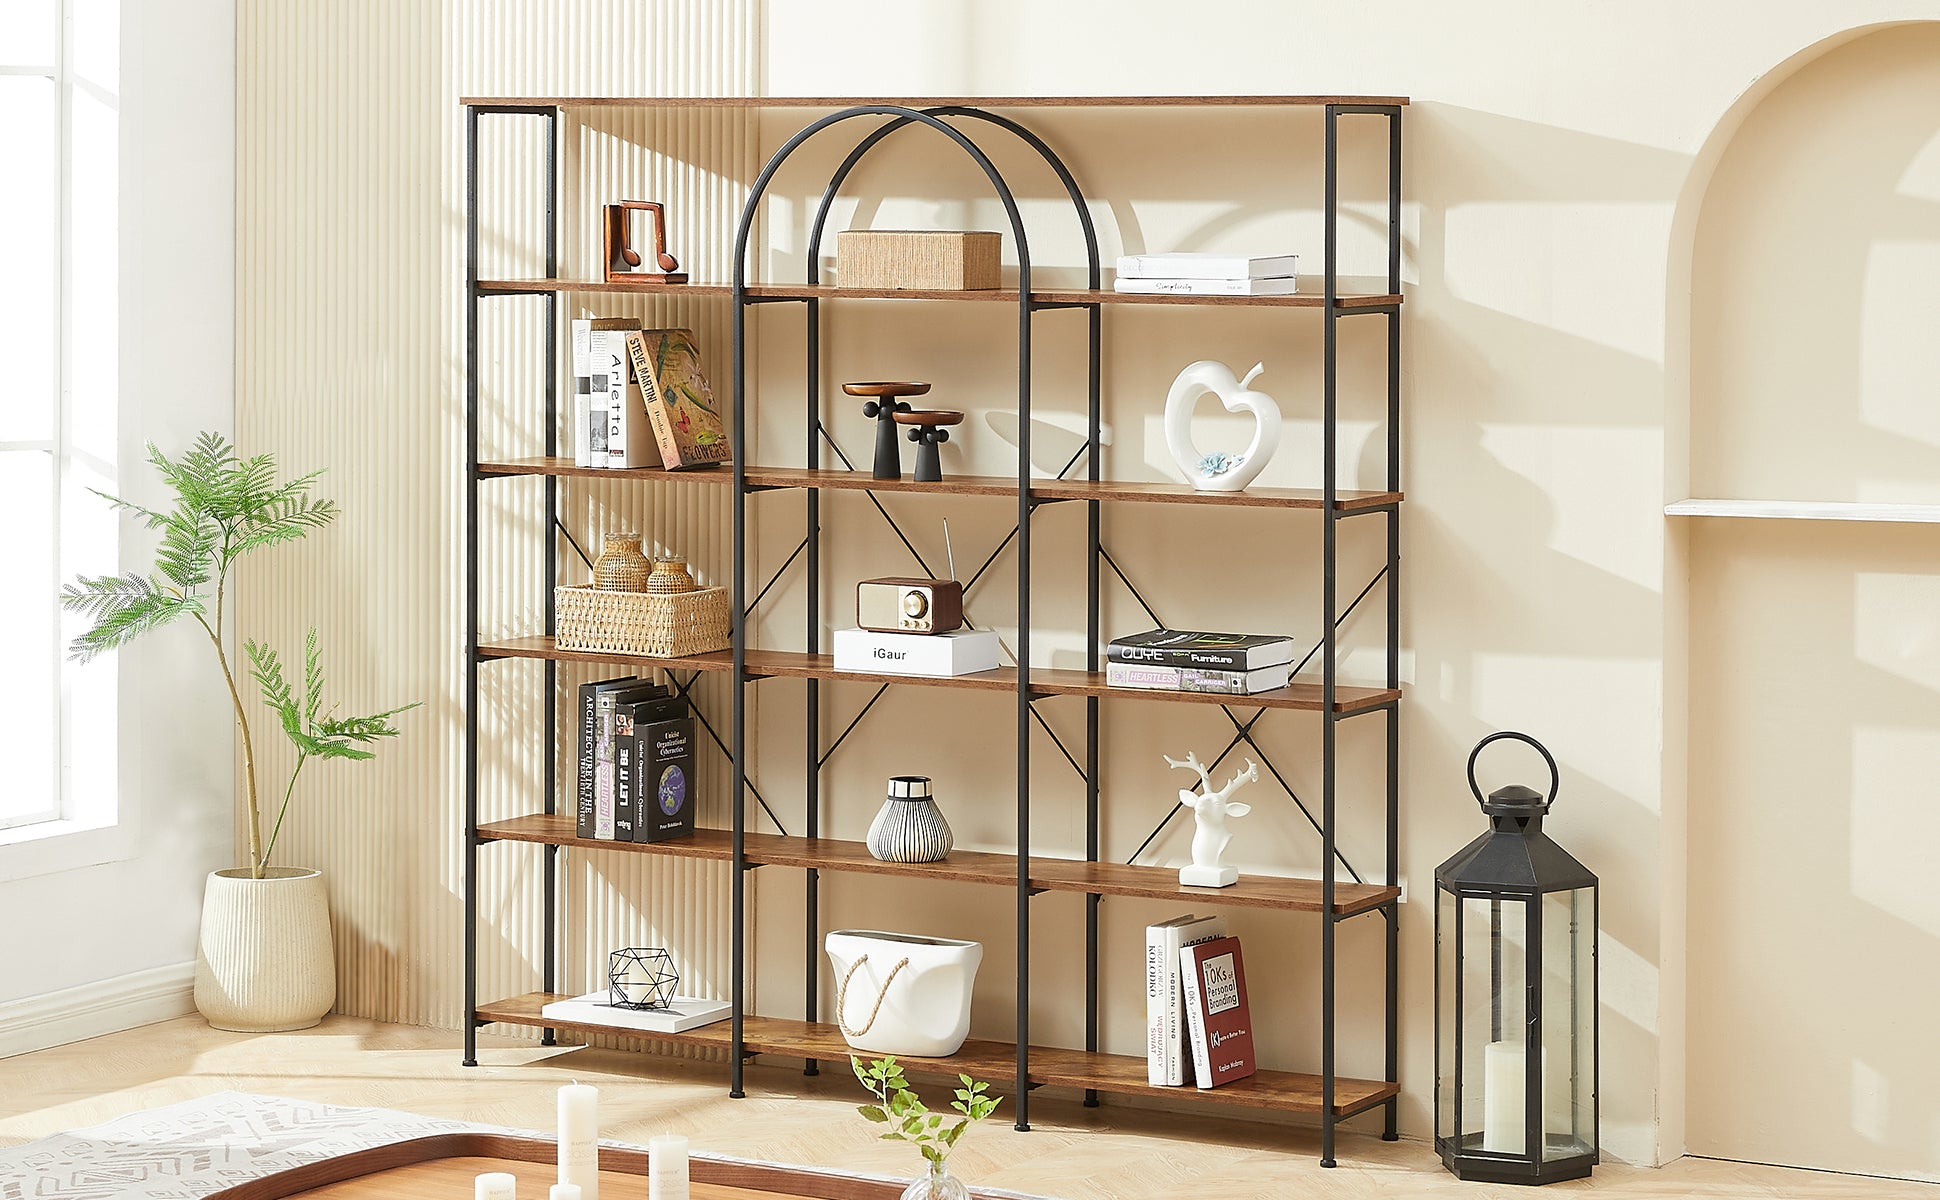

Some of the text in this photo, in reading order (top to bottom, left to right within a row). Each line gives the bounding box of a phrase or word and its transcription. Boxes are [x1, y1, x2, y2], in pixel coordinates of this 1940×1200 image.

[629, 337, 646, 368] STEVE
[638, 366, 658, 404] MARTINI
[611, 354, 622, 436] Arletta
[683, 441, 727, 462] FLOWERS
[873, 648, 907, 660] iGaur
[1191, 653, 1233, 664] Furniture
[1130, 672, 1178, 684] HEARTLESS
[585, 778, 592, 789] IN
[619, 748, 629, 806] LET IT BE
[600, 763, 610, 816] HEARTLESS
[1205, 966, 1234, 985] 10Ks of
[1207, 979, 1236, 998] Personal
[1209, 993, 1238, 1010] Branding
